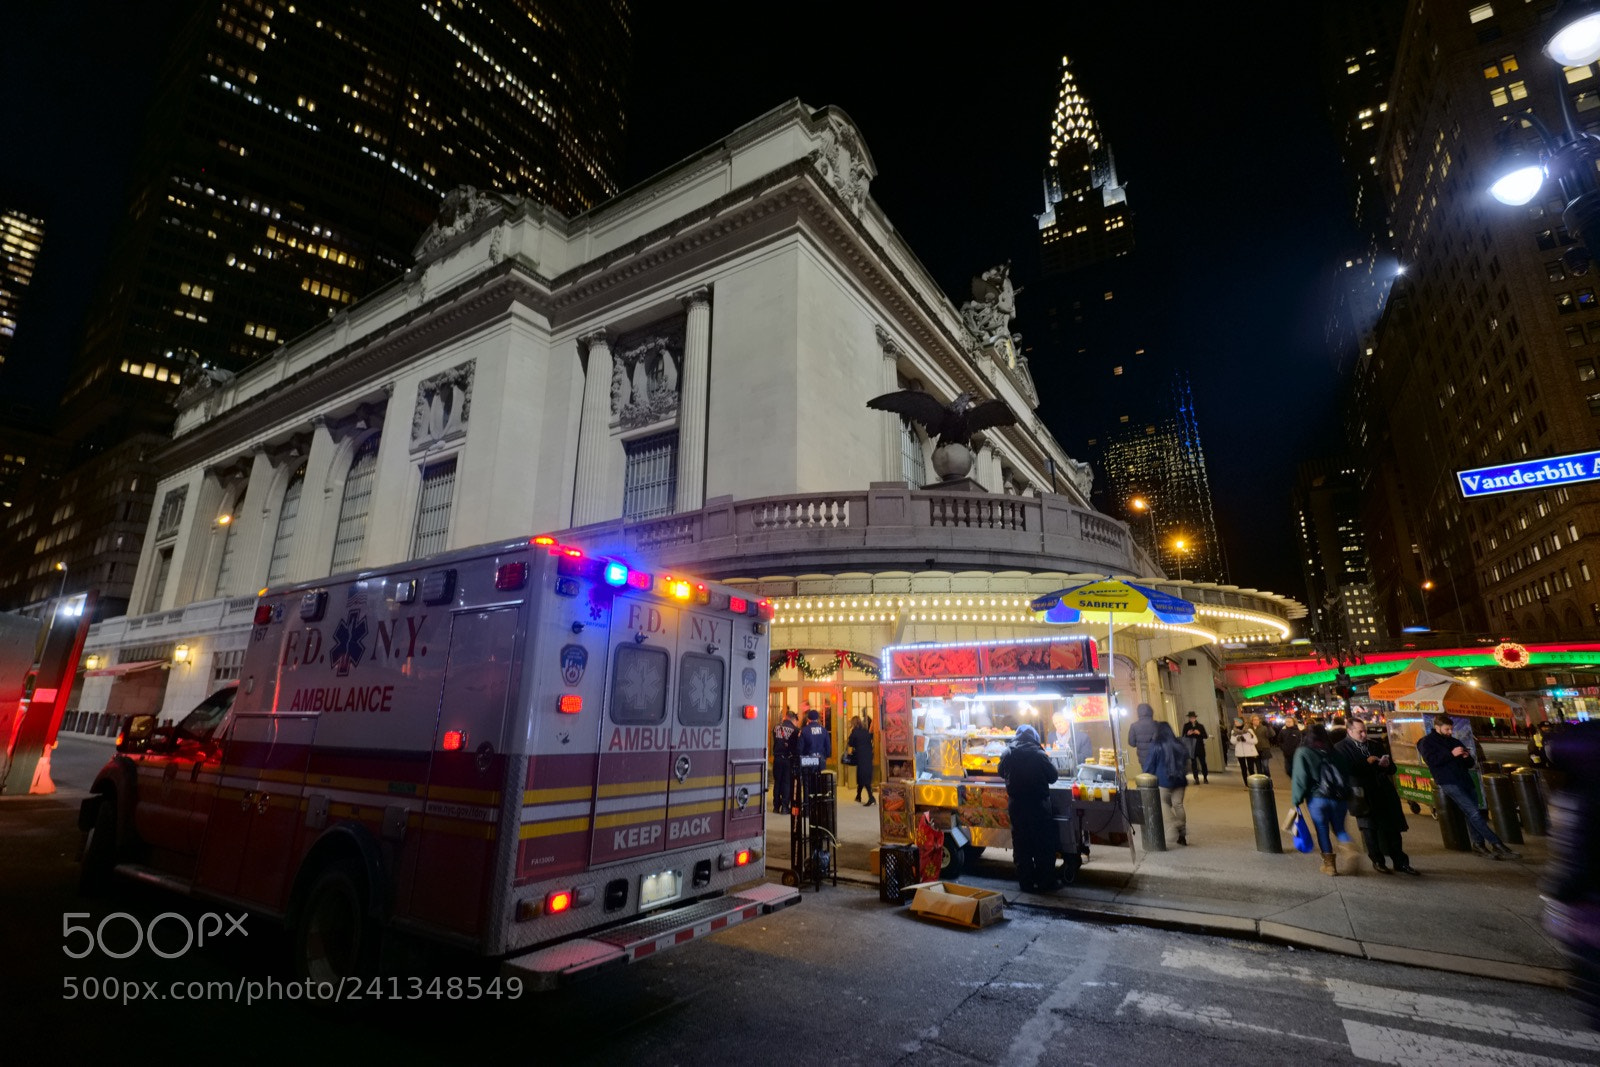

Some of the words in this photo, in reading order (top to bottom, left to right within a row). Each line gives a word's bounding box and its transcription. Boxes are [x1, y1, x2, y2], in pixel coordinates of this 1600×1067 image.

[1462, 461, 1586, 491] Vanderbilt
[1079, 600, 1128, 609] SABRETT
[256, 628, 268, 642] 157
[628, 604, 666, 634] F.D.
[690, 617, 721, 644] N.Y.
[284, 629, 325, 666] F.D.
[372, 616, 427, 660] N.Y.
[743, 635, 759, 650] 157
[291, 687, 393, 712] AMBULANCE
[1399, 701, 1415, 711] NUTS
[1420, 701, 1439, 711] NUTS
[608, 727, 722, 751] AMBULANCE
[1399, 774, 1414, 789] NUTS
[1416, 776, 1432, 792] NUTS
[613, 824, 662, 851] KEEP
[668, 816, 711, 840] BACK
